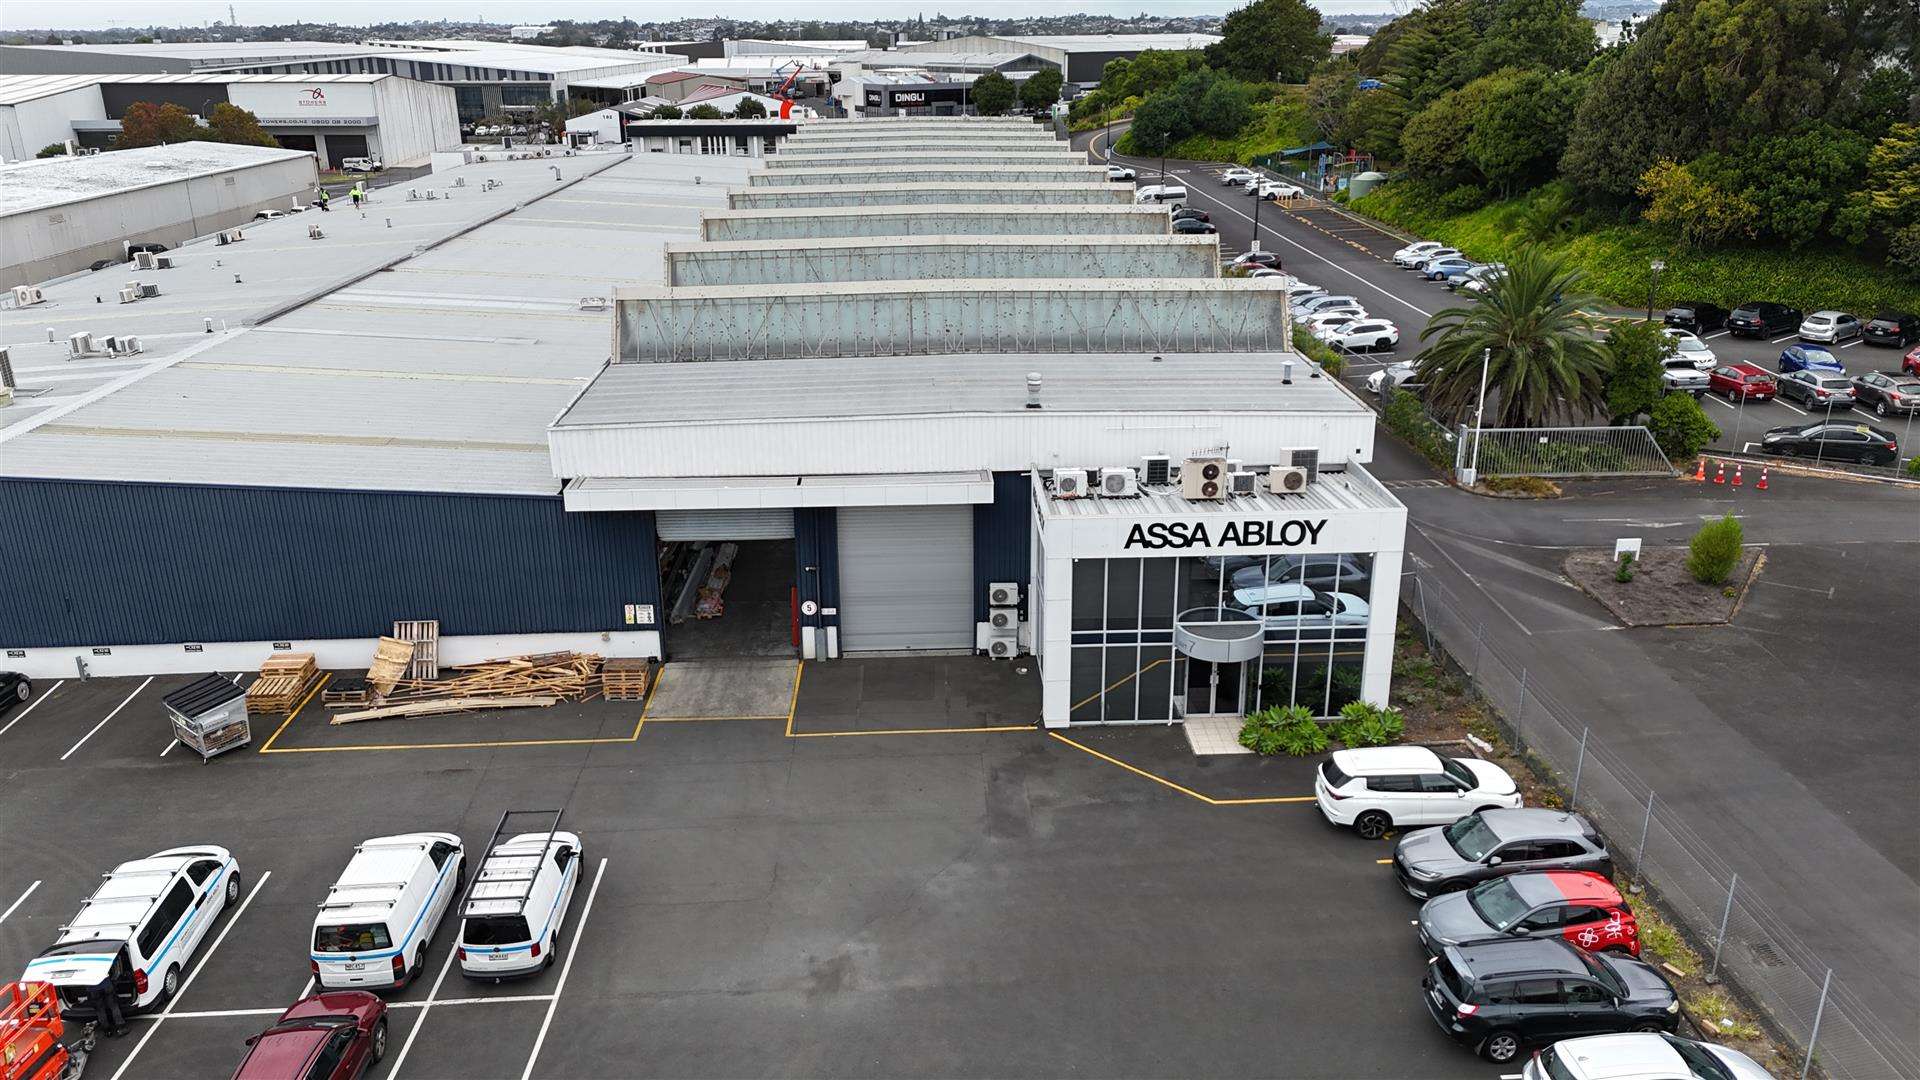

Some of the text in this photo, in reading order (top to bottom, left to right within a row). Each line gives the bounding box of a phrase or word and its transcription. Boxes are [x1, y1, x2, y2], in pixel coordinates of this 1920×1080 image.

[895, 92, 925, 102] DINGLI
[1124, 518, 1329, 549] ASSA ABLOY
